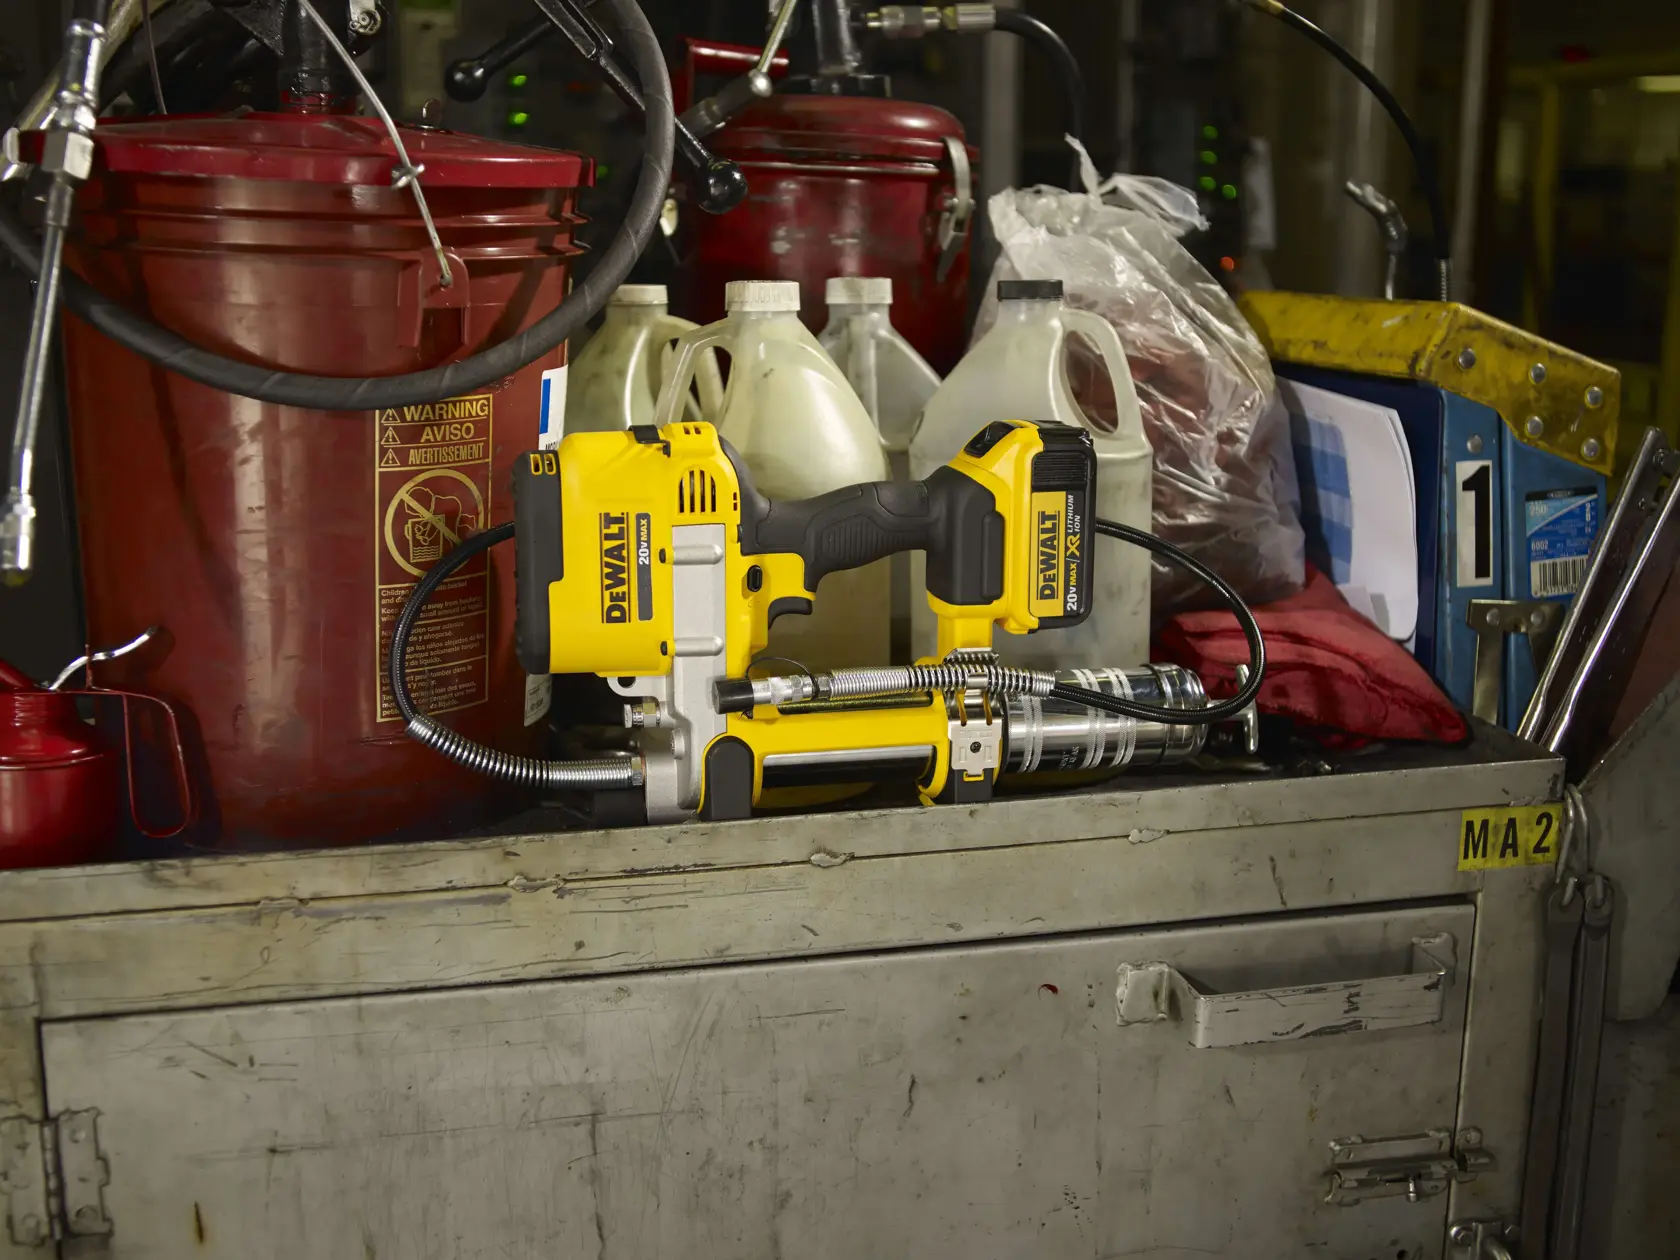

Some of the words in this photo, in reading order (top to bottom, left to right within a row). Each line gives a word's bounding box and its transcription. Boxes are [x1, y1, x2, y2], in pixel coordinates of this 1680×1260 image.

[404, 400, 489, 421] WARNING
[420, 423, 474, 442] AVISO
[408, 443, 484, 465] AVERTISSEMENT
[1462, 465, 1490, 578] 1
[603, 512, 627, 623] DEWALT
[1039, 511, 1057, 600] DEWALT
